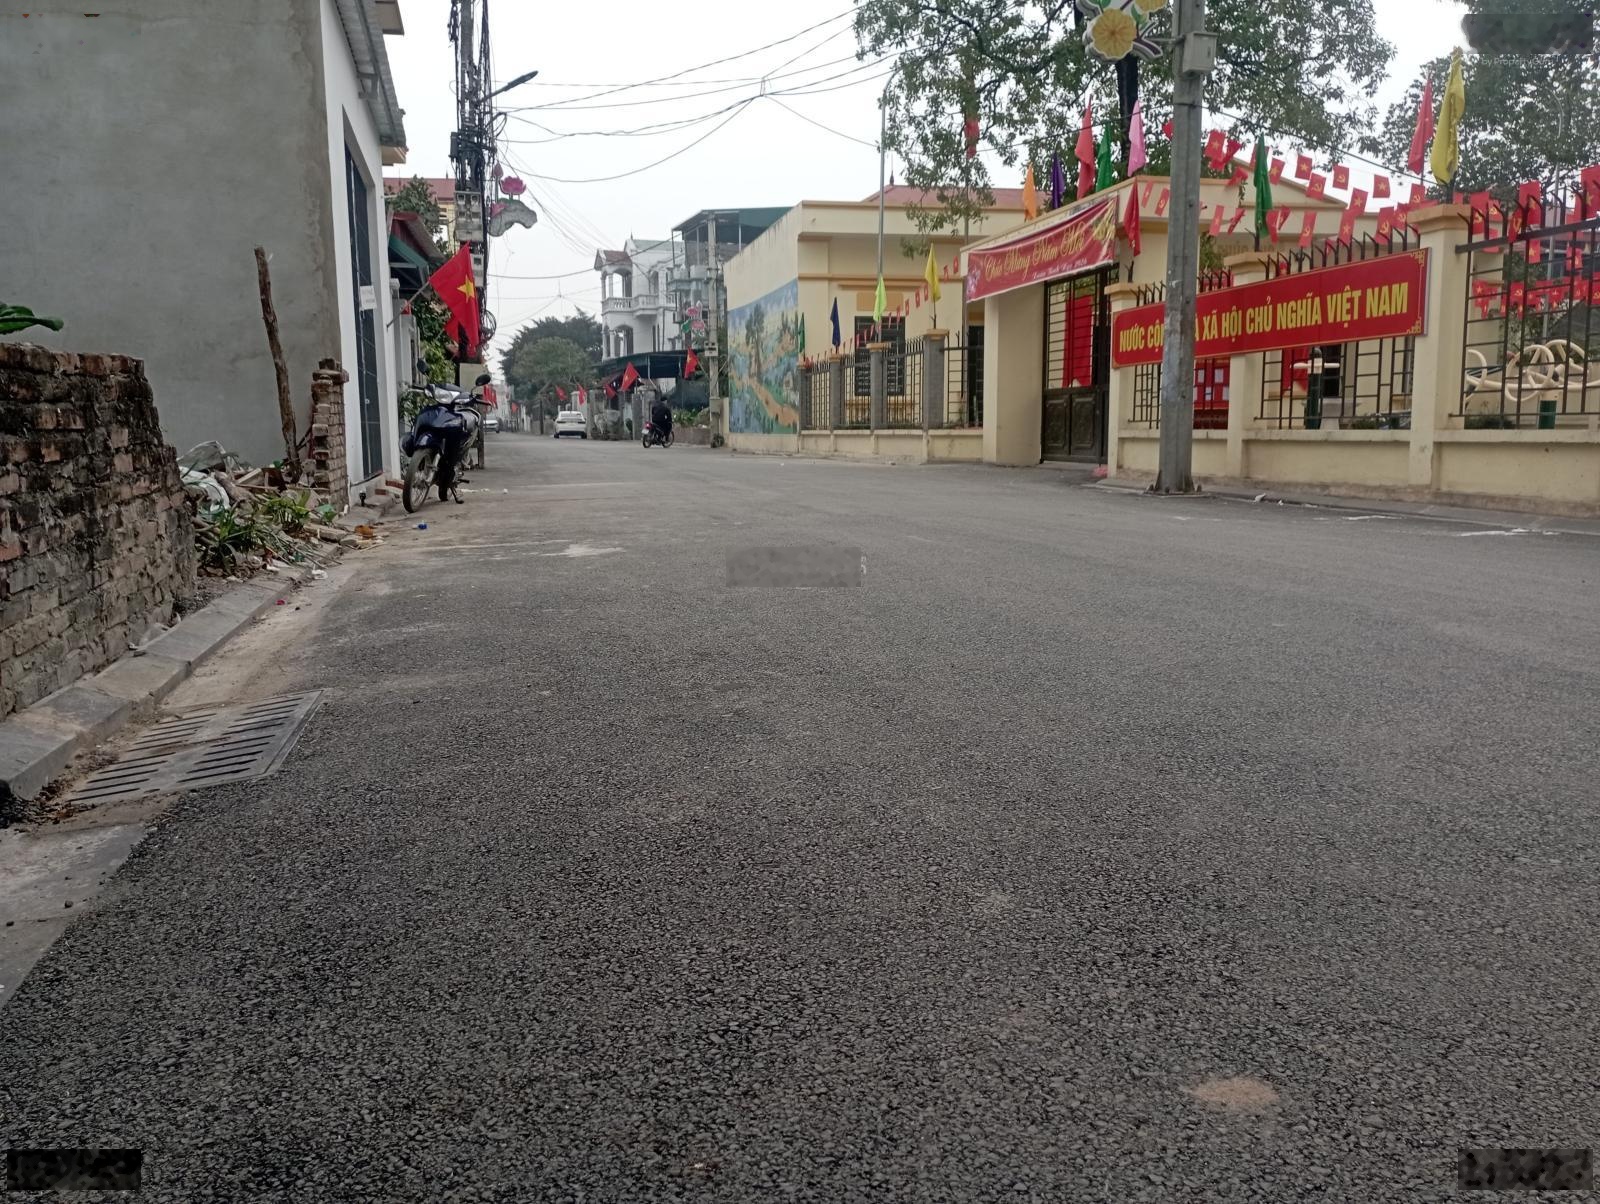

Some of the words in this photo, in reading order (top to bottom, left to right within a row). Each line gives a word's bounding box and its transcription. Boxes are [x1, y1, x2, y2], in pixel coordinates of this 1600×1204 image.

[1119, 324, 1145, 352] NƯỚC
[1203, 310, 1218, 341] XÃ
[1222, 306, 1242, 342] HỘI
[1246, 296, 1272, 334] CHỦ
[1276, 293, 1322, 330] NGHĨA
[1326, 285, 1362, 328] VIỆT
[1365, 282, 1409, 317] NAM
